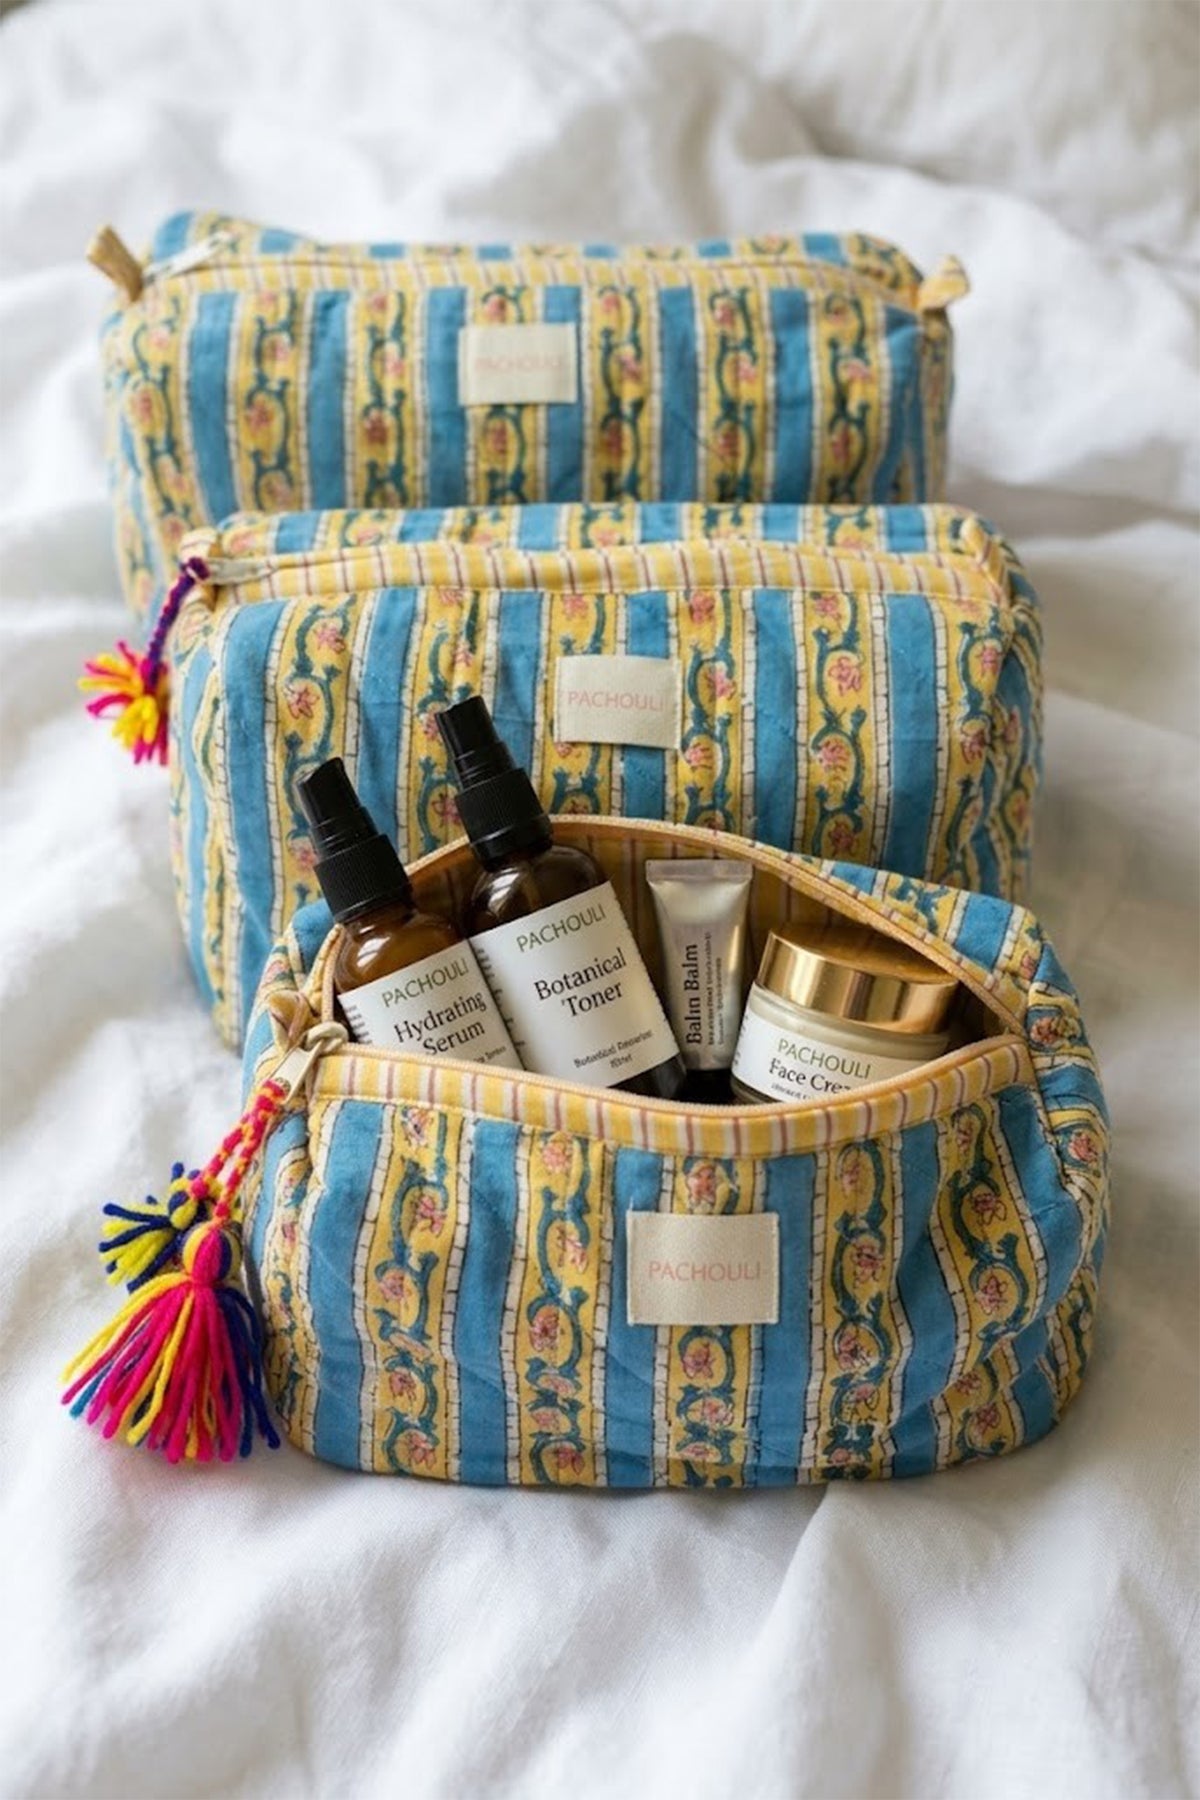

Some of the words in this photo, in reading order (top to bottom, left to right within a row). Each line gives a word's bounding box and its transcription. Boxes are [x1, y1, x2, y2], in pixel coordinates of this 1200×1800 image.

[568, 689, 664, 713] PACHOULI
[516, 903, 607, 953] PACHOULI
[381, 957, 470, 1008] PACHOULI
[534, 947, 627, 1001] Botanical
[681, 943, 700, 991] Balm
[394, 991, 487, 1043] Hydrating
[562, 981, 624, 1018] Toner
[423, 1021, 486, 1056] Serum
[777, 1038, 872, 1080] PACHOULI
[769, 1057, 807, 1086] Face
[810, 1072, 853, 1094] Cre
[648, 1260, 762, 1282] PACHOULI
